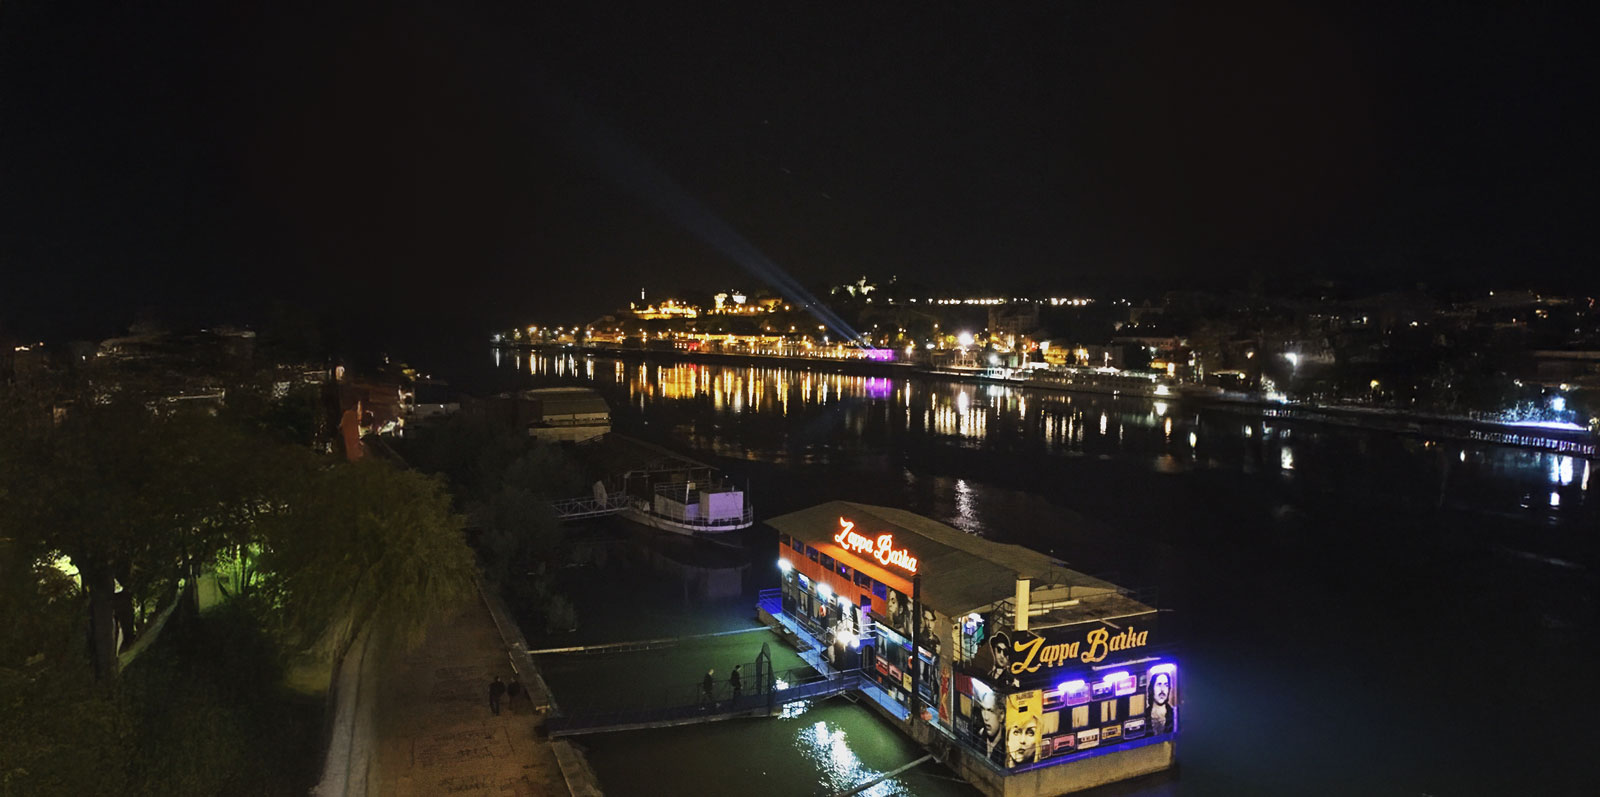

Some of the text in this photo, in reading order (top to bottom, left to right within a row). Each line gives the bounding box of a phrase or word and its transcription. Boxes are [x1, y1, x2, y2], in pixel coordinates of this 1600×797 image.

[834, 516, 917, 573] Zappa Barka
[1011, 626, 1149, 675] Zappa Barka
